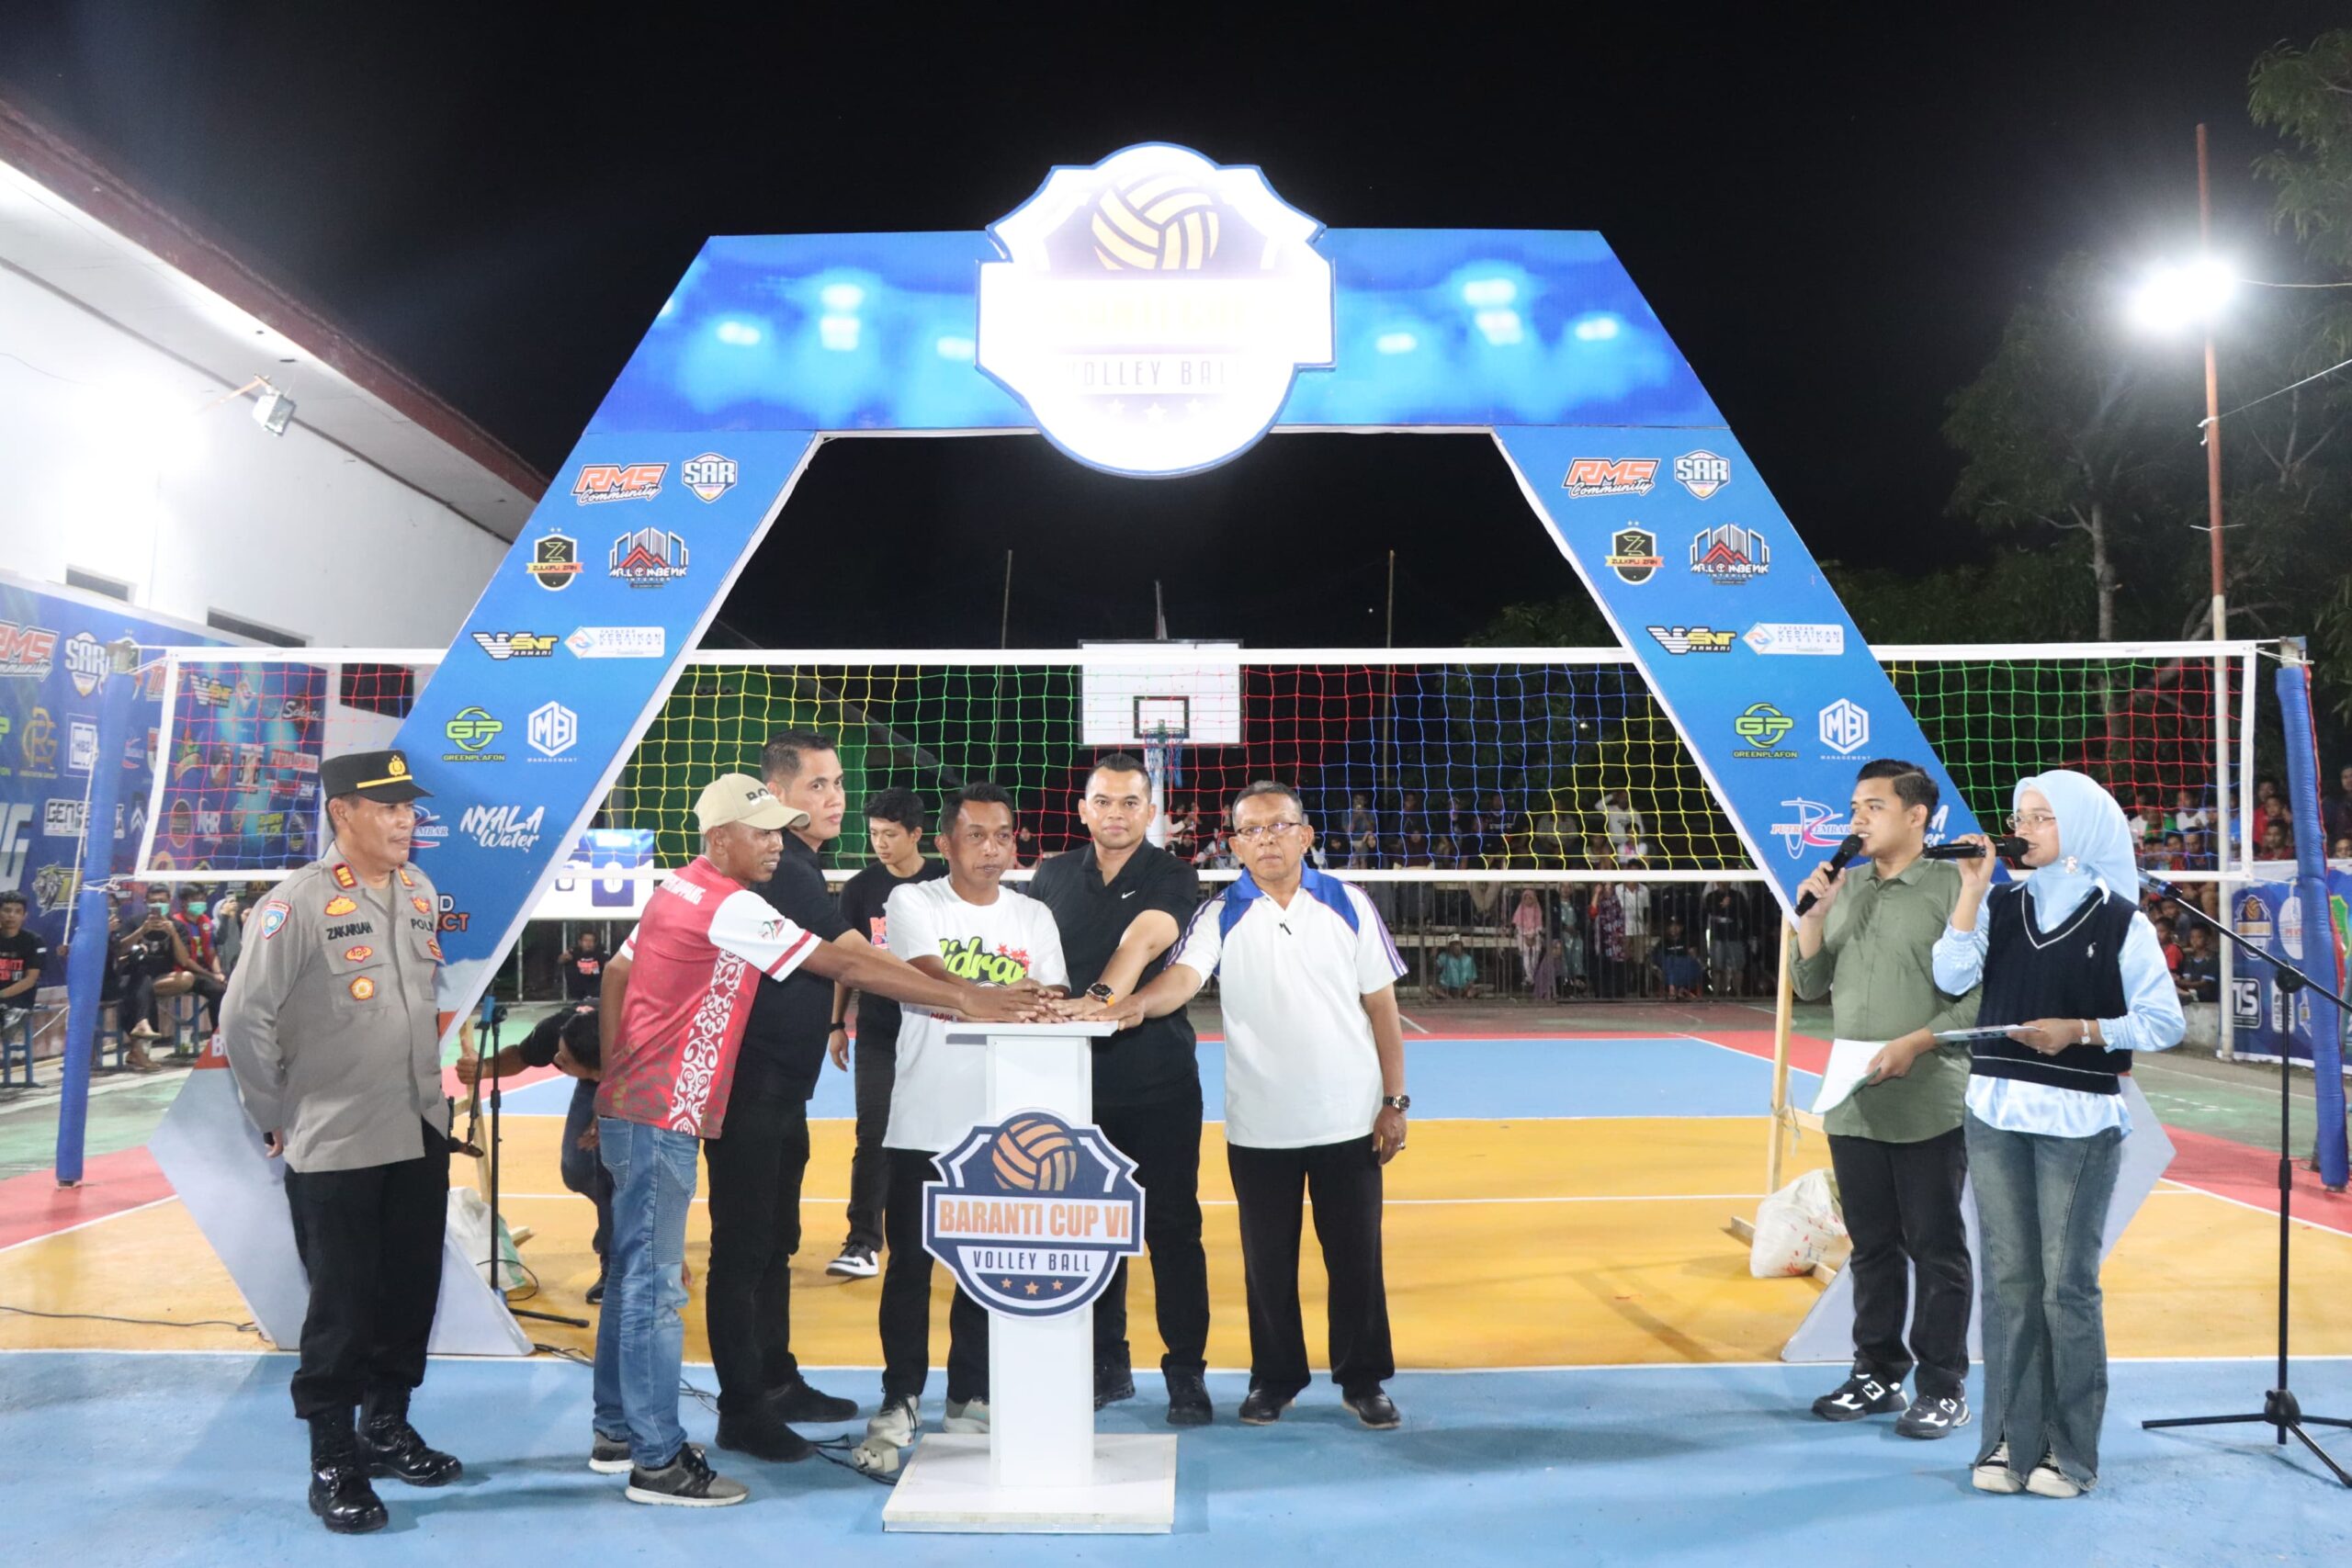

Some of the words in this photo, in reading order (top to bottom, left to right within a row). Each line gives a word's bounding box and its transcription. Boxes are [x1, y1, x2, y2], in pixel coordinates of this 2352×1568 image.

[1181, 360, 1239, 387] BAL
[573, 464, 668, 493] RMS
[683, 461, 737, 485] SAR
[1564, 460, 1659, 487] RMS
[1676, 459, 1728, 481] SAR
[579, 483, 662, 504] Community
[1570, 479, 1654, 498] Community
[65, 638, 107, 673] SAR
[447, 720, 503, 739] GP
[1735, 716, 1793, 735] GP
[443, 753, 505, 761] GREENPLAFON
[1734, 750, 1798, 759] GREENPLAFON
[413, 826, 448, 836] EMBAR
[459, 805, 545, 836] NYALA
[480, 829, 540, 848] Water
[939, 1200, 1044, 1235] BARANTI
[1049, 1203, 1099, 1237] CUP
[1104, 1205, 1130, 1238] VI
[973, 1250, 1036, 1271] VOLLEY
[1048, 1253, 1091, 1273] BALL
